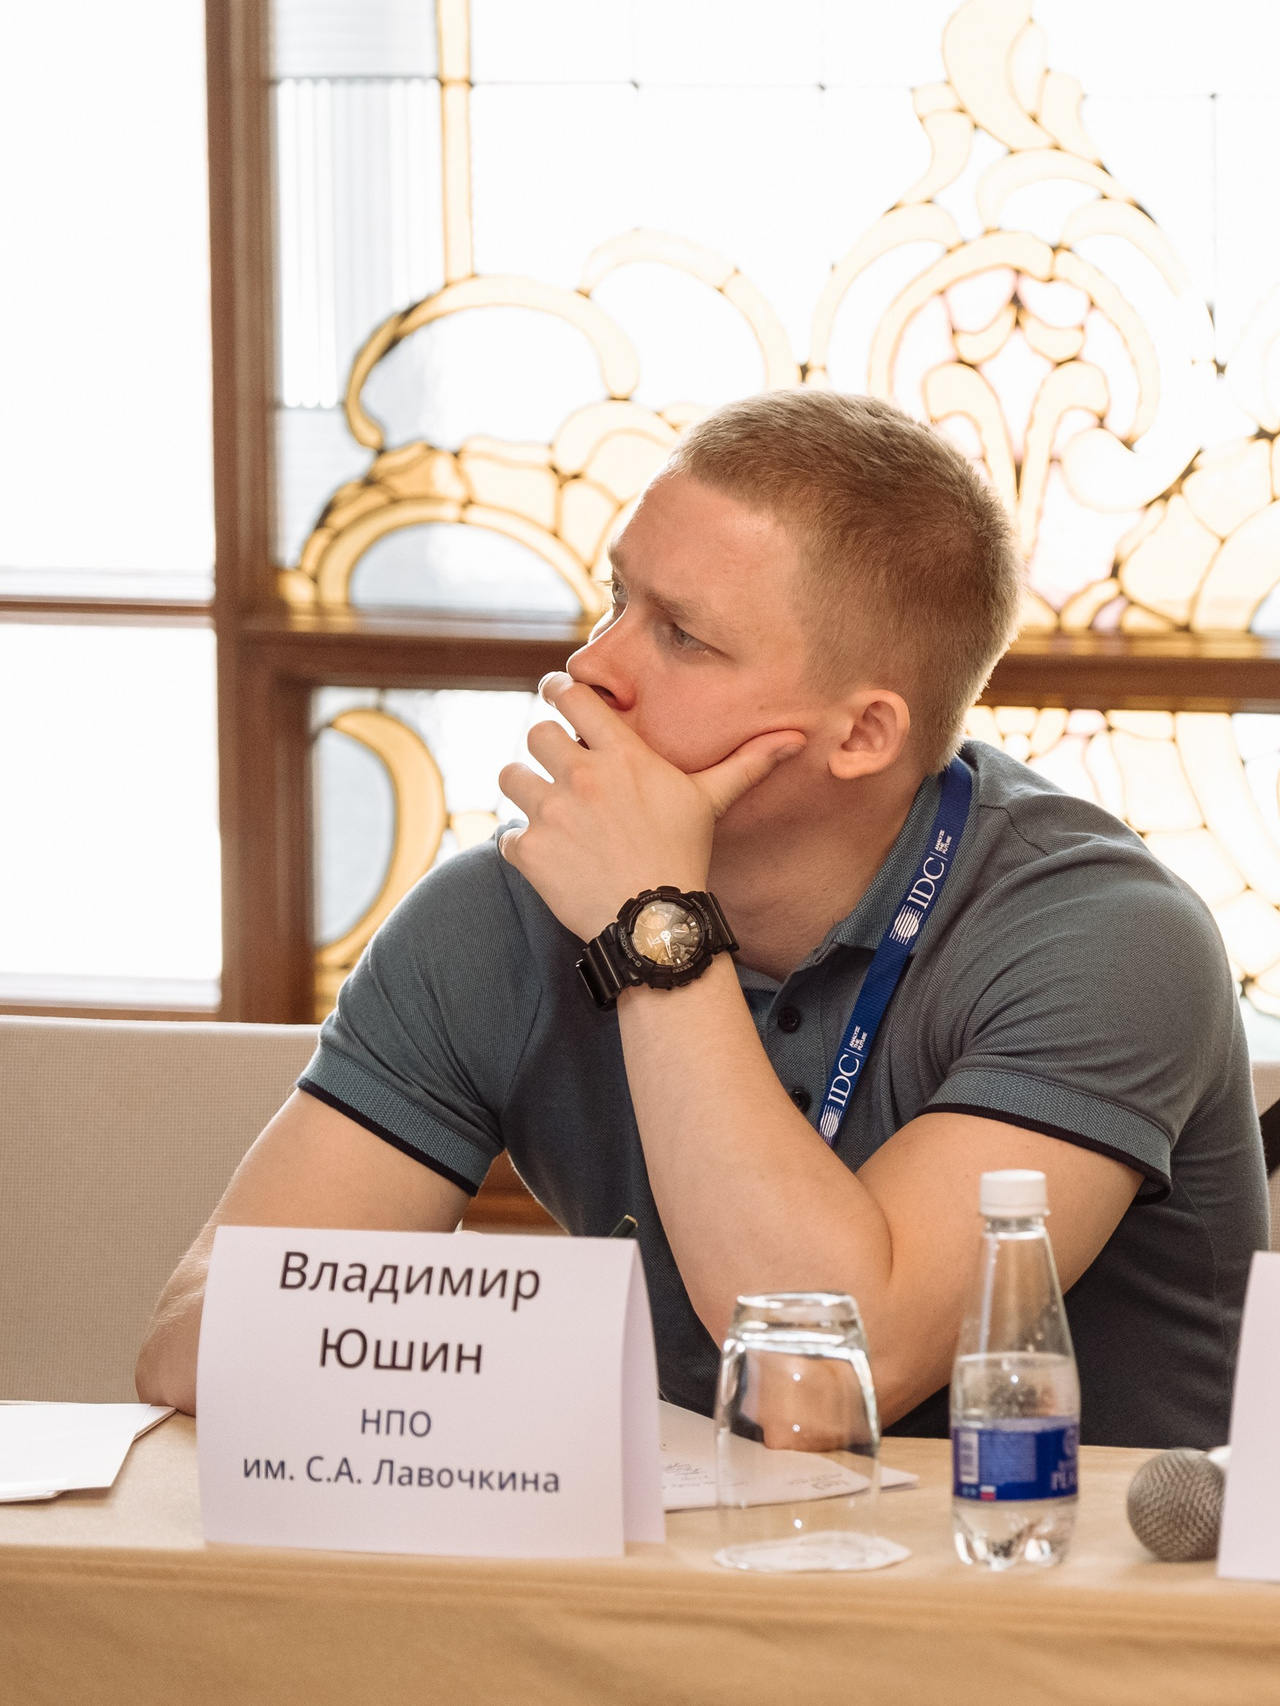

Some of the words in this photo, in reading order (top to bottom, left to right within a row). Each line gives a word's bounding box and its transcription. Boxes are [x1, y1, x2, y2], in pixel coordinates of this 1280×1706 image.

[906, 856, 945, 910] IDC
[620, 926, 642, 968] G-SHOCK
[827, 1053, 860, 1107] IDC
[279, 1250, 541, 1313] Владимир
[318, 1327, 484, 1376] Юшин
[360, 1407, 432, 1438] НПО
[243, 1458, 295, 1482] им.
[305, 1455, 362, 1485] С.А.
[371, 1458, 560, 1494] Лавочкина
